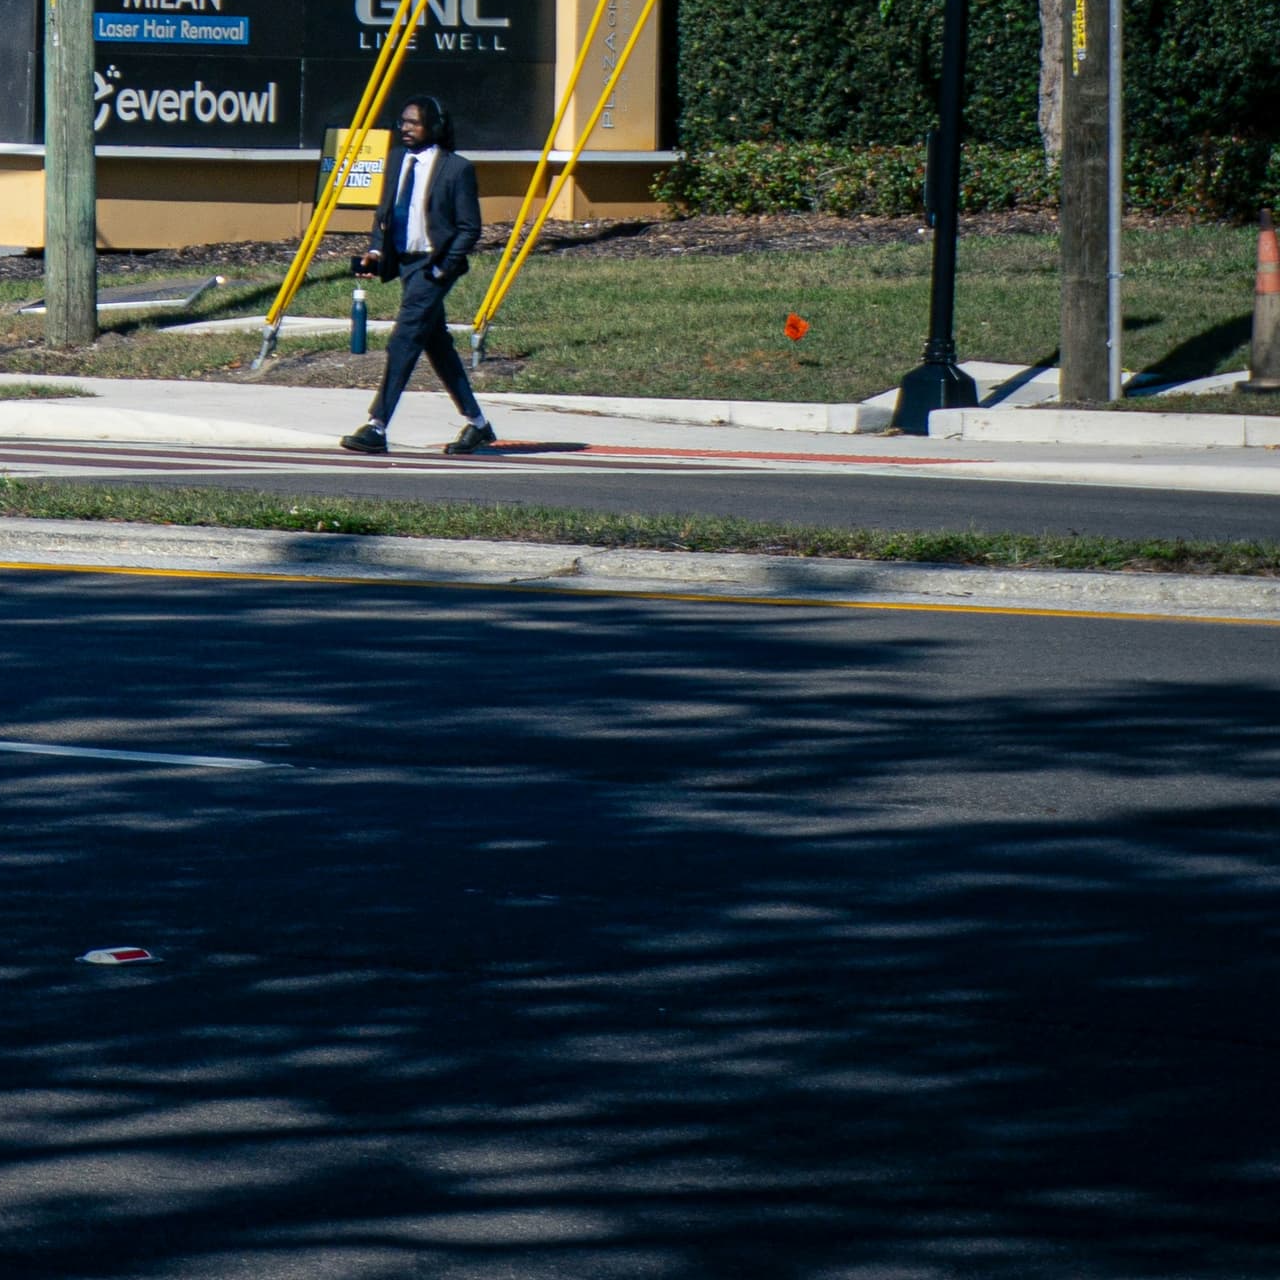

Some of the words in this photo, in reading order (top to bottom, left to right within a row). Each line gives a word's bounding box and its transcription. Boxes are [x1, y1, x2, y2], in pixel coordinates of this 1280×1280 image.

[99, 18, 140, 38] Laser
[143, 19, 176, 39] Hair
[181, 20, 245, 41] Removal
[434, 32, 508, 52] WELL
[116, 80, 278, 123] everbowl
